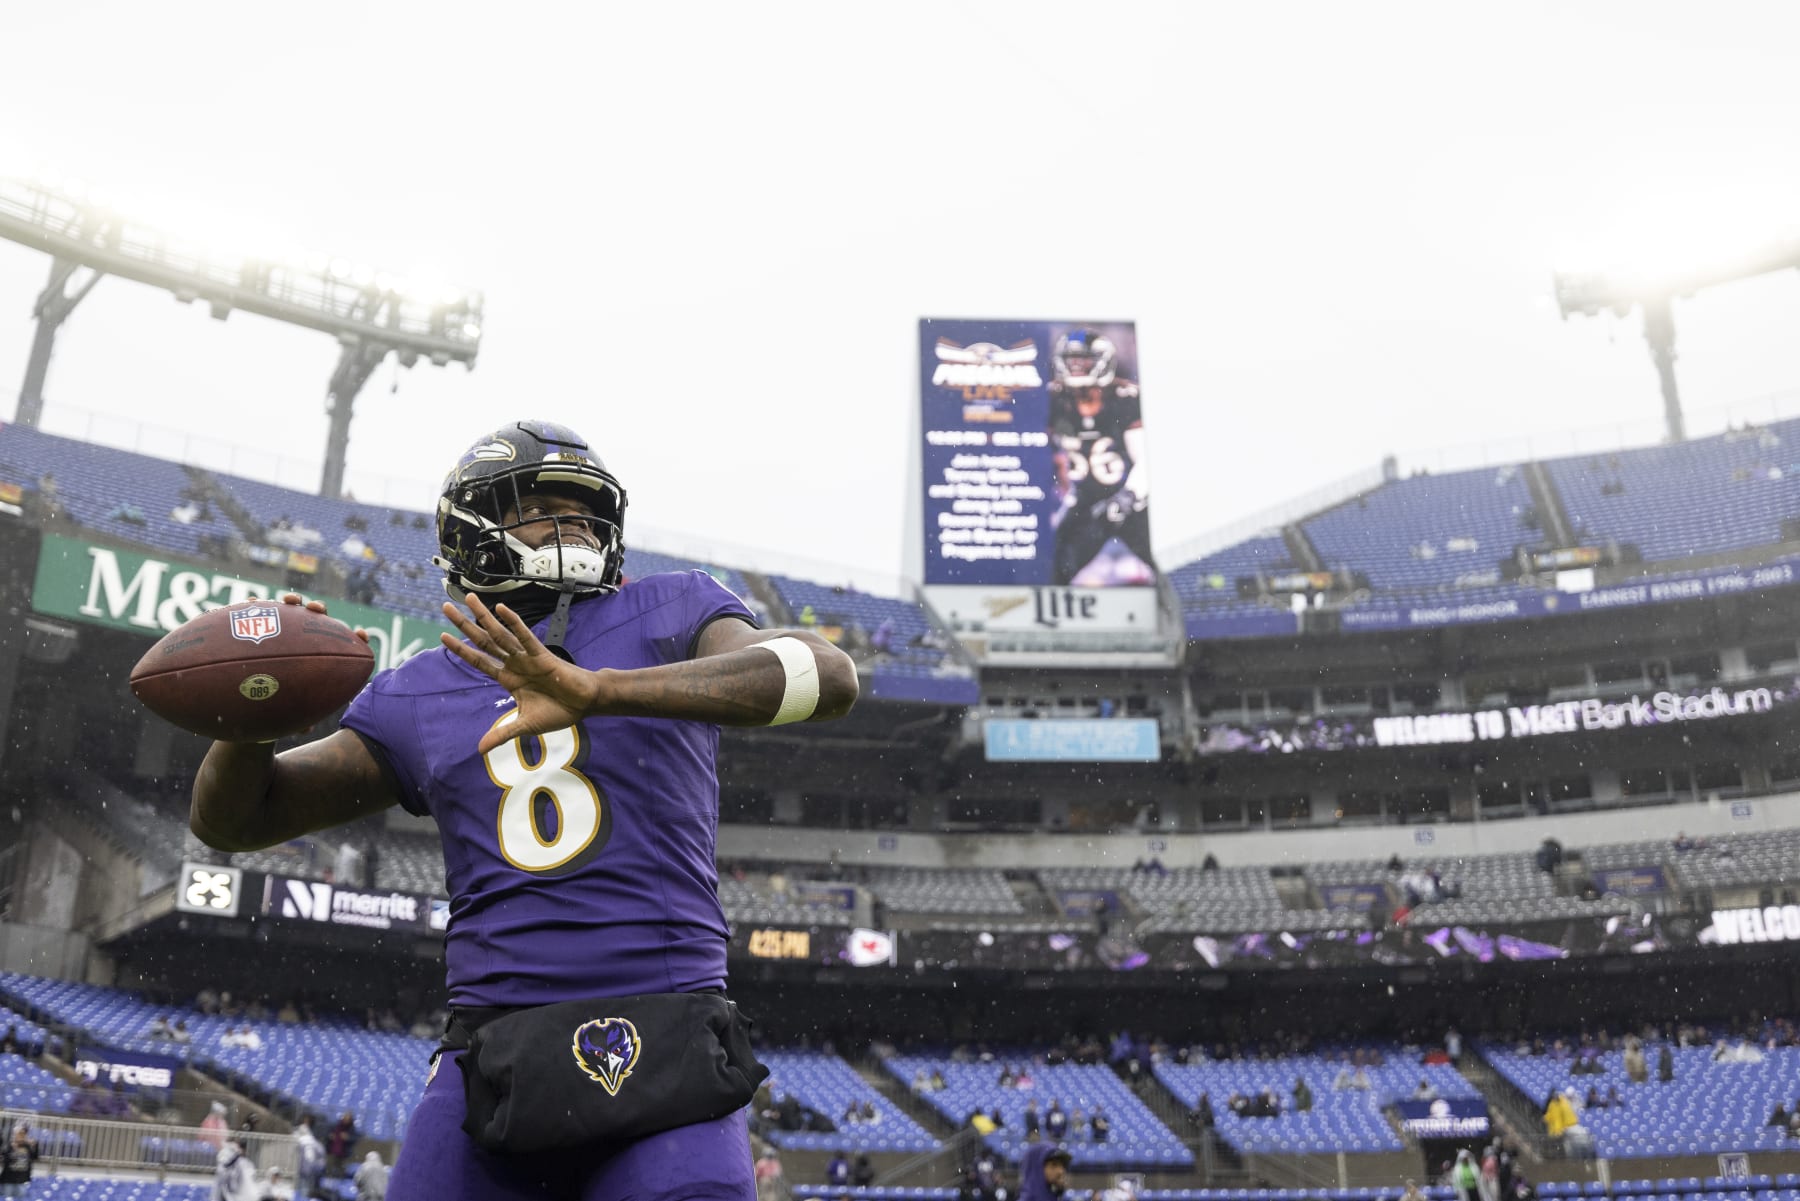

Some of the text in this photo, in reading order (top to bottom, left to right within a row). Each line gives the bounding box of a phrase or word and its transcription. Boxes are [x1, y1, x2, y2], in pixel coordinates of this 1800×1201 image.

[236, 617, 275, 637] NFL
[1032, 586, 1097, 628] Lite
[250, 686, 269, 698] 089
[1373, 686, 1773, 746] WELCOME TO M&T Bank Stadium
[483, 706, 608, 873] 8
[333, 891, 418, 922] merritt
[1711, 905, 1800, 945] WELCO
